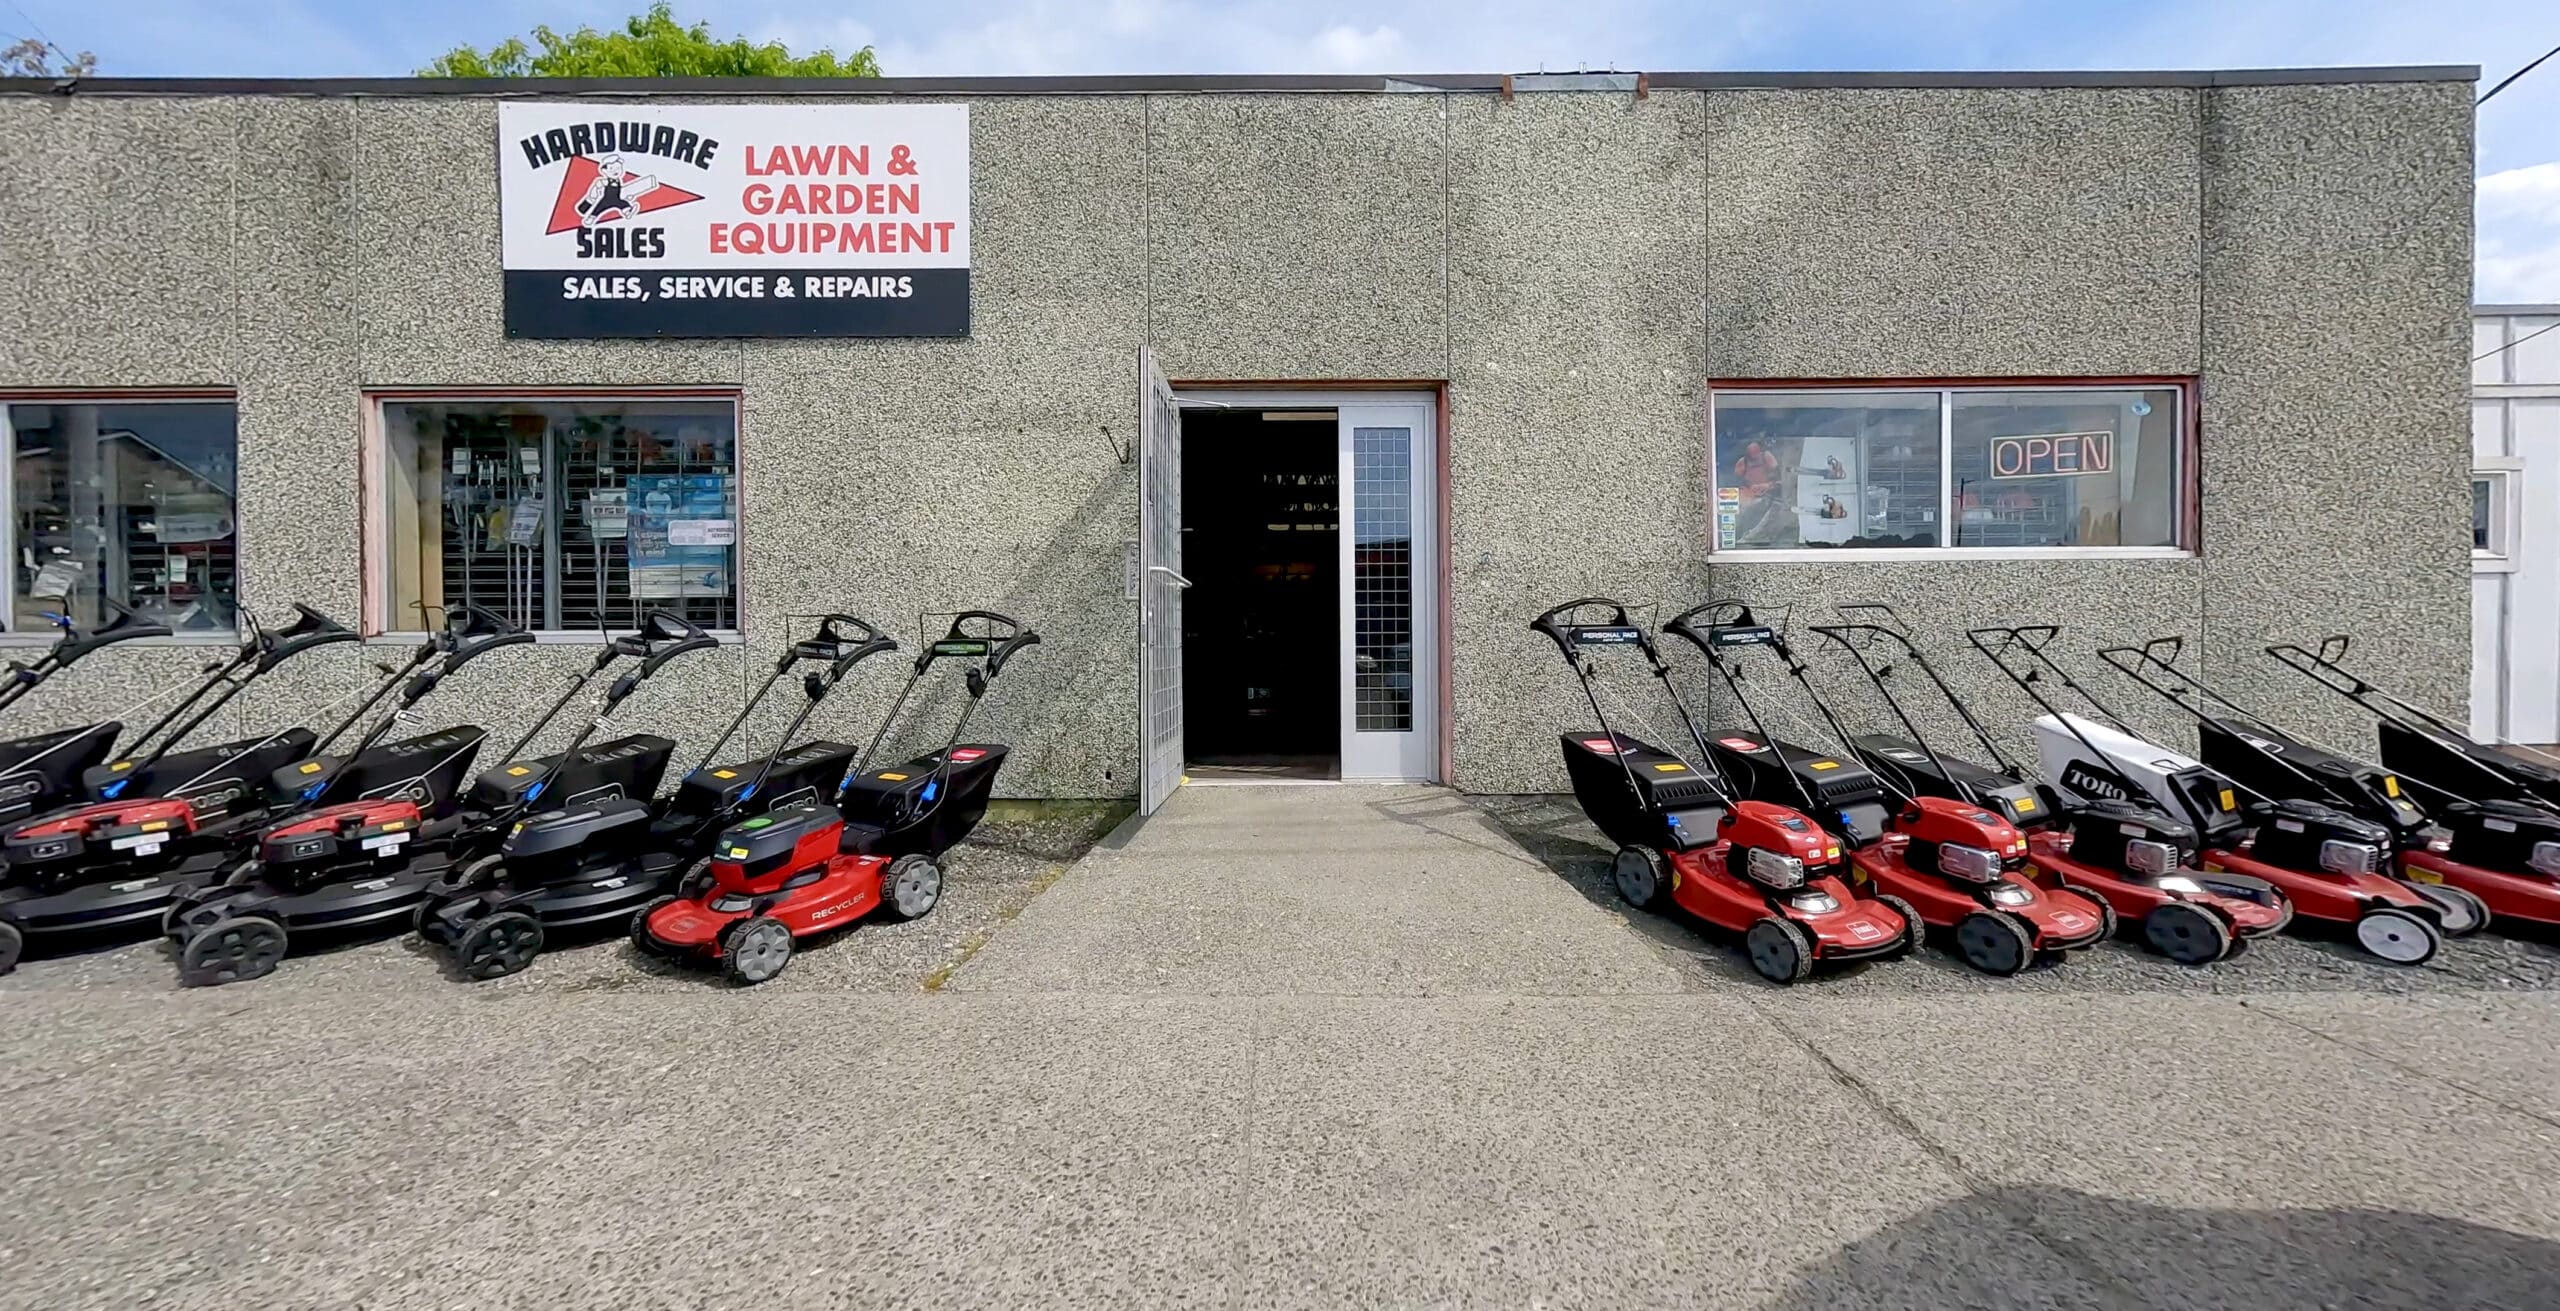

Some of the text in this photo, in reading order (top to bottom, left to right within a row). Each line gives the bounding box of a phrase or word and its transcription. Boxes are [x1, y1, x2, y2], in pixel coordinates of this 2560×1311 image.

[520, 121, 719, 171] HARDWARE
[744, 143, 918, 177] LAWN &
[741, 183, 920, 215] GARDEN
[576, 227, 665, 259] SALES
[709, 221, 956, 255] EQUIPMENT
[562, 275, 914, 302] SALES, SERVICE & REPAIRS
[1996, 435, 2108, 475] OPEN
[2070, 769, 2128, 801] TORO
[811, 892, 865, 921] RECYCLER
